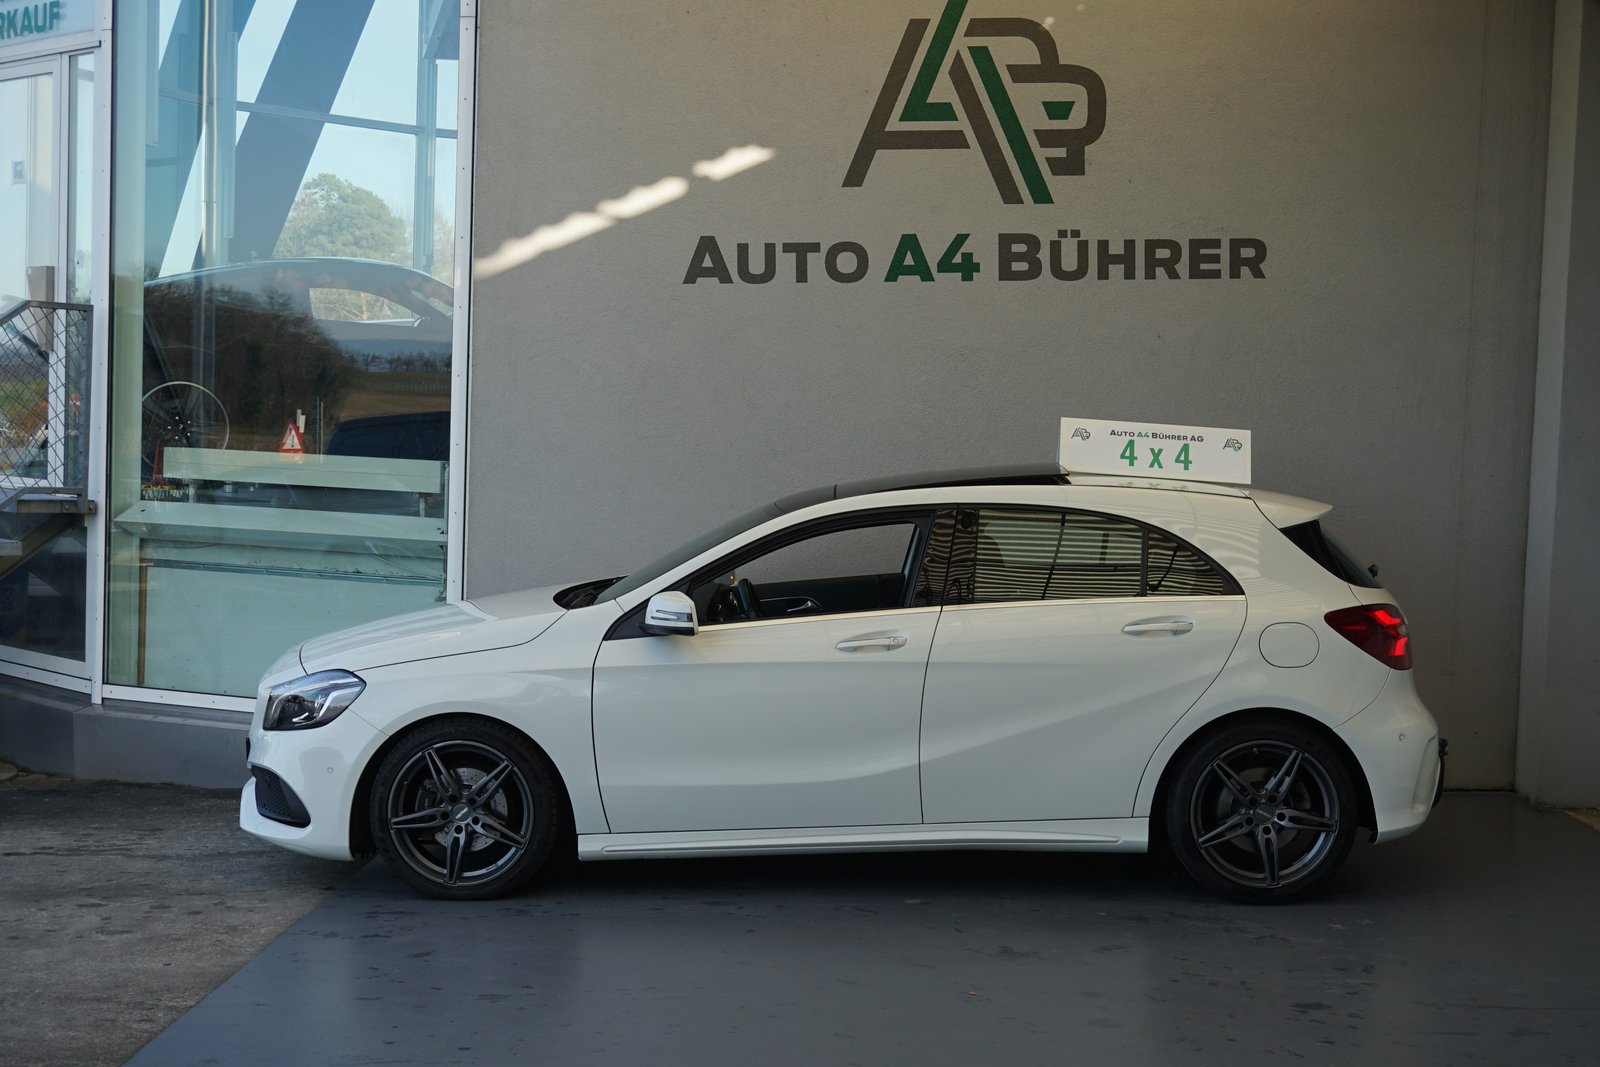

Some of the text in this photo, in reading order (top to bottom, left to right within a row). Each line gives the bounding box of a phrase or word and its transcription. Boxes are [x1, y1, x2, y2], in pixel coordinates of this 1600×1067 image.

[884, 233, 980, 283] A4
[1120, 439, 1138, 467] 4
[1174, 443, 1193, 471] 4
